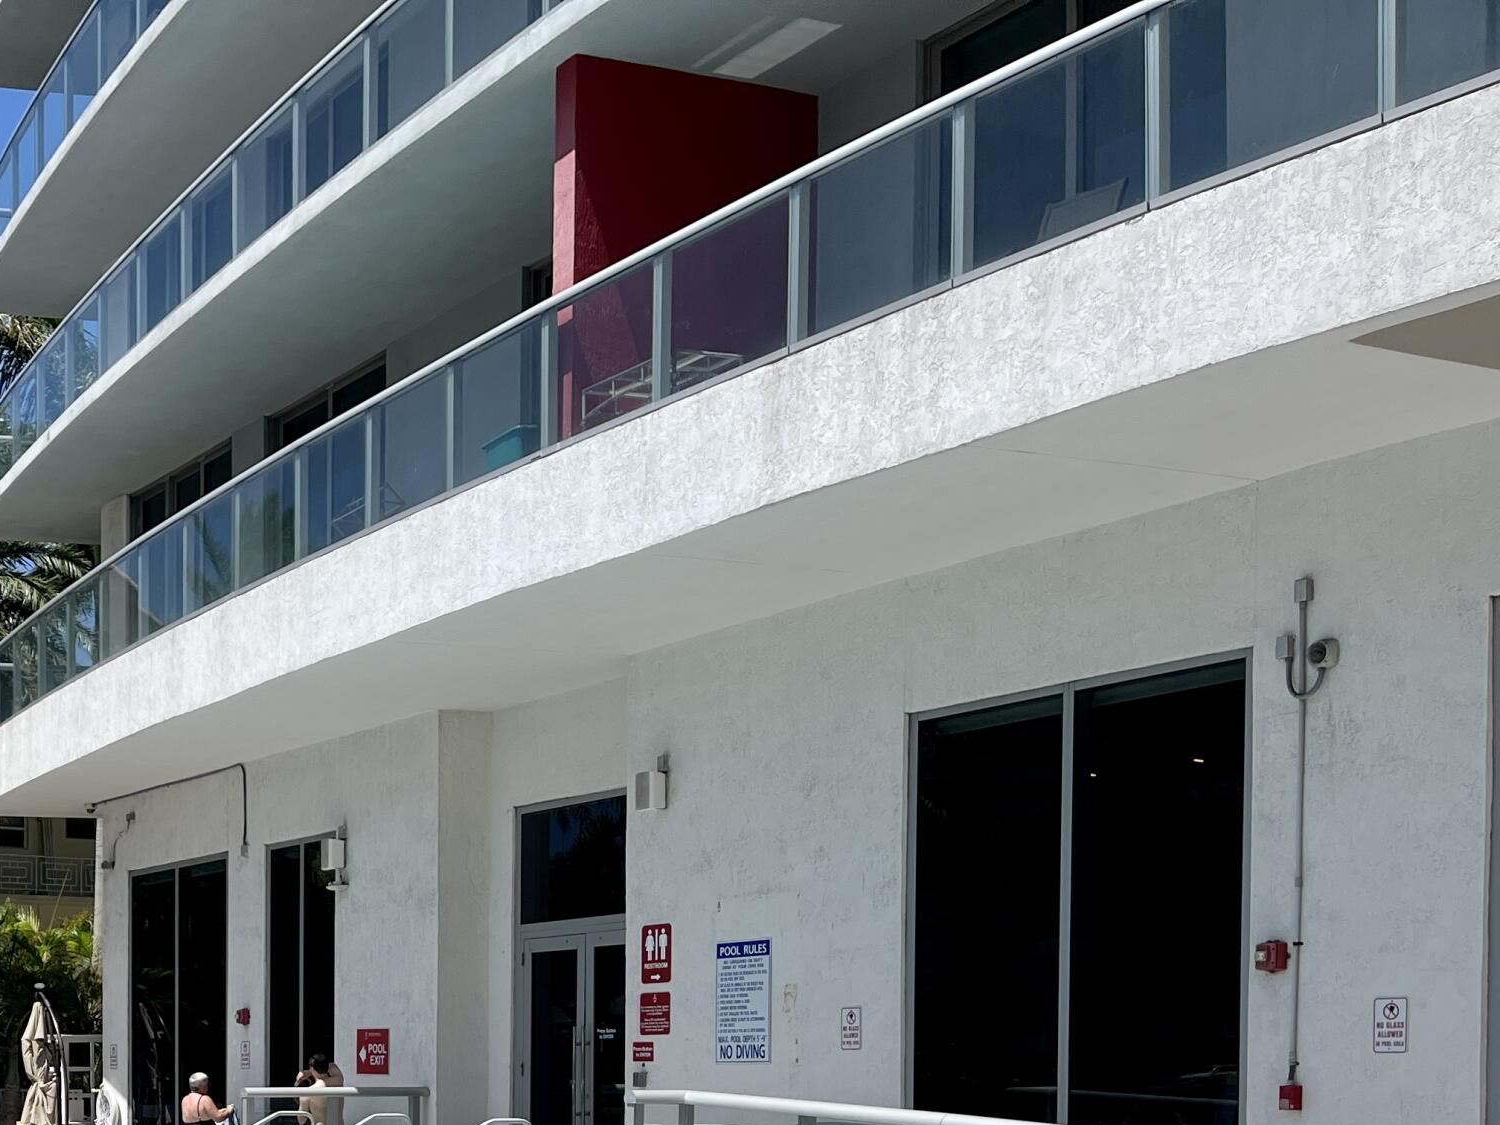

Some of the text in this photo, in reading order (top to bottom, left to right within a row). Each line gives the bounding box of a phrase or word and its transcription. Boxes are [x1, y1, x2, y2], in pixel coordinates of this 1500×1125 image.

[719, 943, 767, 957] POOL RULES
[1386, 1021, 1404, 1029] GLASS
[1377, 1030, 1403, 1038] ALLOWED
[368, 1043, 387, 1054] POOL
[719, 1043, 766, 1059] NO DIVING
[370, 1055, 385, 1066] EXIT
